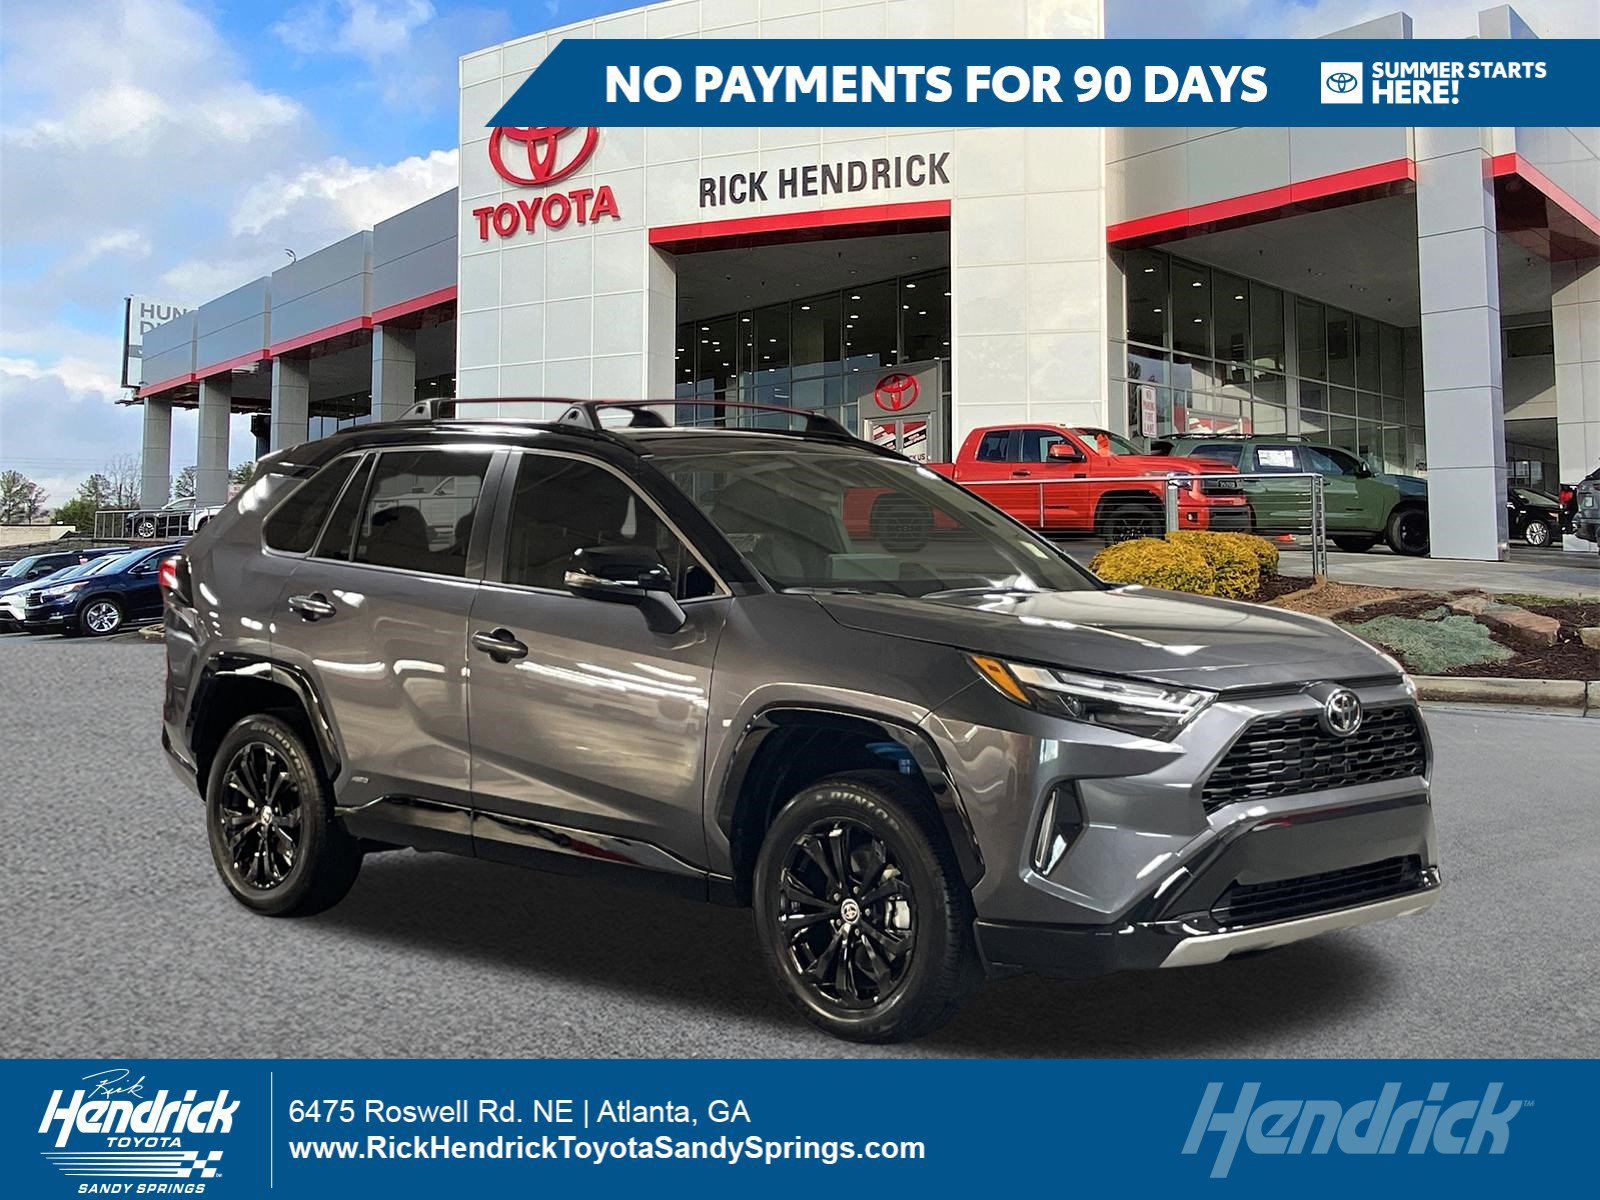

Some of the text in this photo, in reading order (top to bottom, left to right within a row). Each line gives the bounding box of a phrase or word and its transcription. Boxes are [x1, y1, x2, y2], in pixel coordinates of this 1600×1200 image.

[699, 151, 951, 208] RICK HENDRICK
[473, 184, 620, 240] TOYOTA
